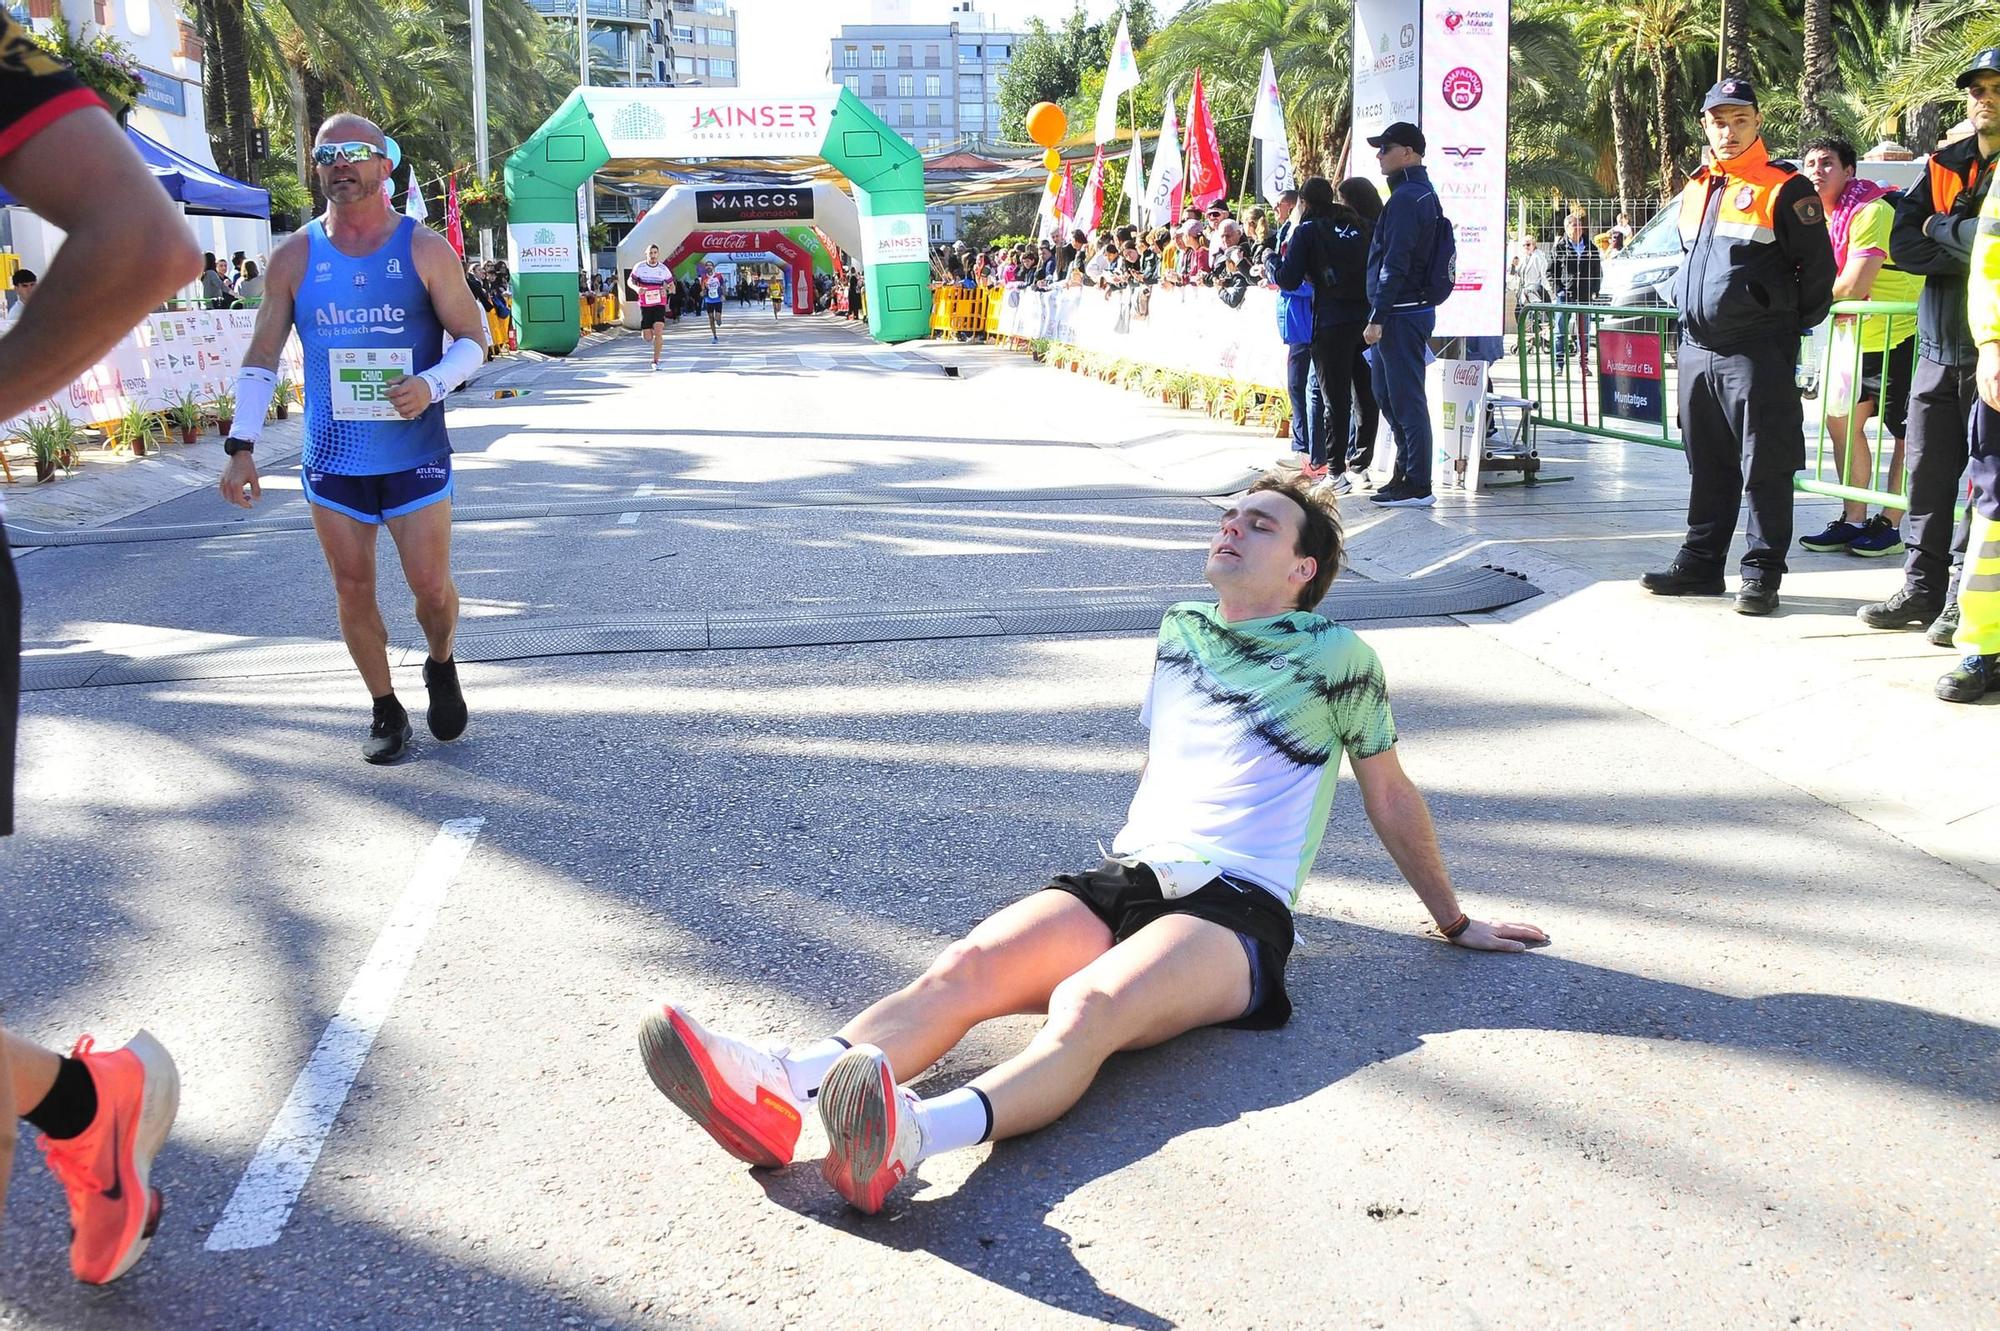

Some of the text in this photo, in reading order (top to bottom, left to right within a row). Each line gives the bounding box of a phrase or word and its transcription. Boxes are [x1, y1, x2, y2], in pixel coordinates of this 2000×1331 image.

[1443, 69, 1481, 93] POMPADOUR
[692, 105, 816, 128] JAINSER
[753, 131, 817, 139] SERVICIOS
[712, 193, 798, 209] MARCOS
[702, 233, 749, 249] Coca-Cola
[878, 237, 923, 249] JAINSER
[521, 247, 569, 258] JAINSER
[316, 302, 405, 325] Alicante
[317, 325, 369, 338] City & Beach
[361, 370, 383, 381] CHIMO
[1614, 391, 1648, 408] Muntatges
